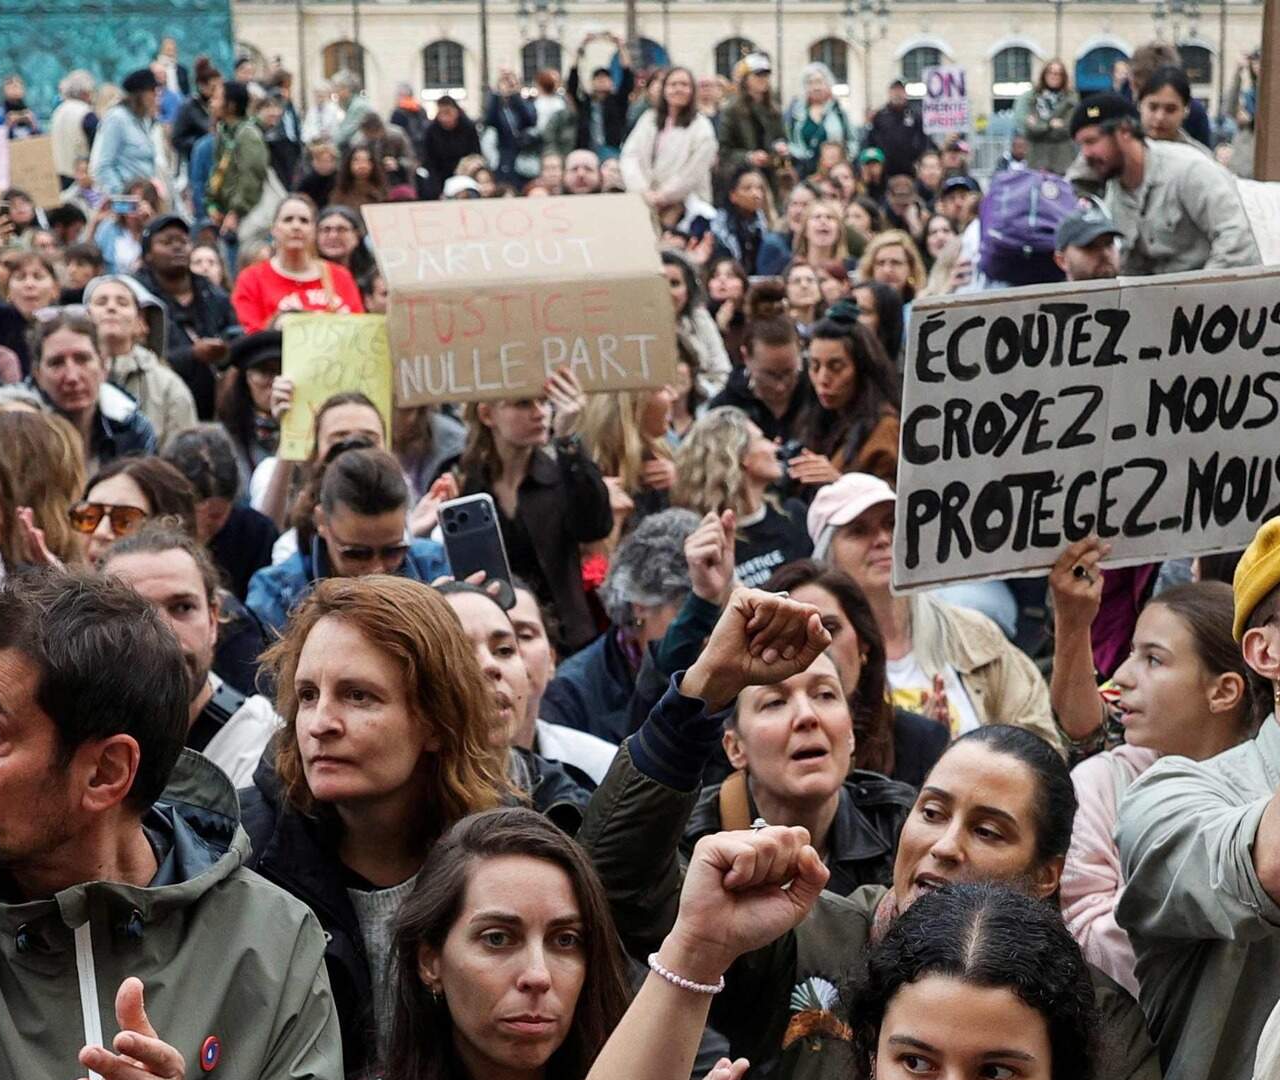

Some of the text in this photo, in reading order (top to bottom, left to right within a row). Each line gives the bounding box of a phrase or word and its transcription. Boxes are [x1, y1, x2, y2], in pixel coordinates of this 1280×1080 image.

[928, 71, 965, 98] ON
[381, 237, 595, 281] PARTOUT
[395, 288, 611, 348] JUSTICE
[398, 334, 658, 400] NULLE PART
